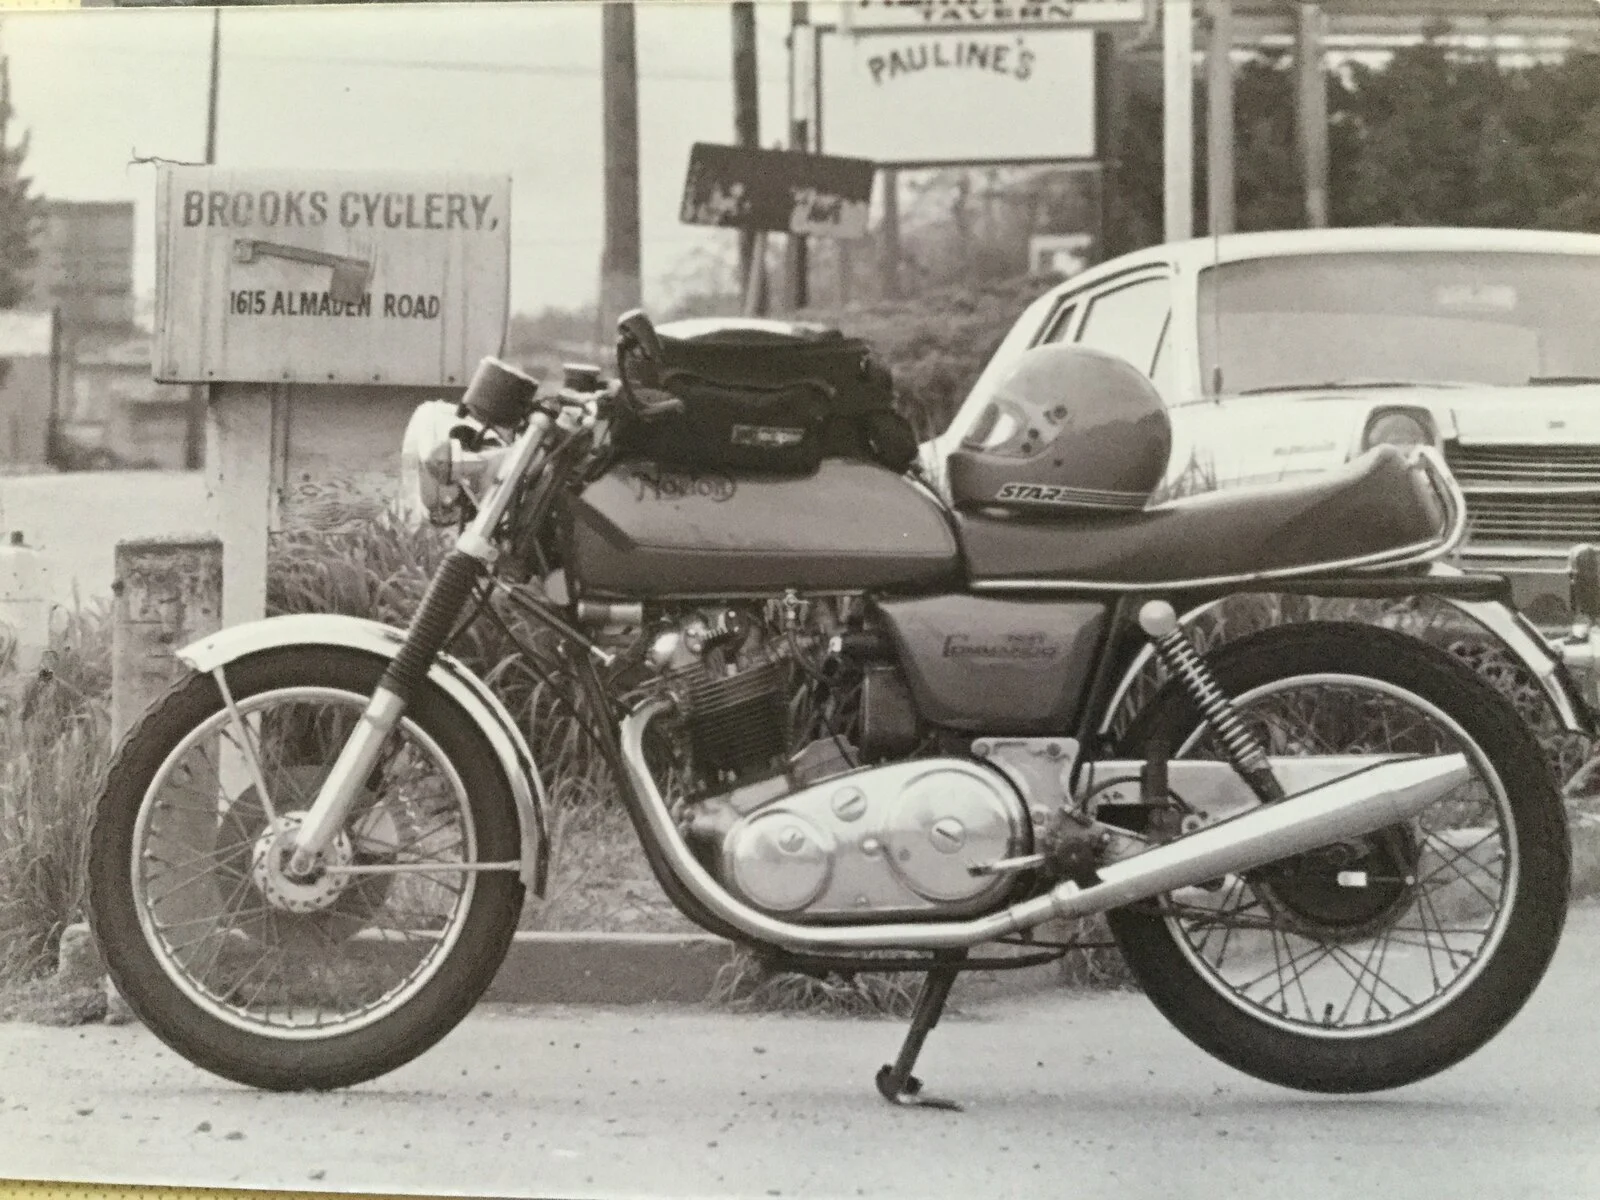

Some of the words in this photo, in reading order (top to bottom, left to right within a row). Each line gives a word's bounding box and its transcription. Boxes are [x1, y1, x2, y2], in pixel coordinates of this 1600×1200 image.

[921, 5, 1073, 21] TAVERN
[867, 37, 1035, 84] PAULINE'S
[183, 190, 329, 227] BROOKS
[338, 193, 498, 231] CYCLERY,
[229, 290, 266, 316] 1615
[383, 292, 441, 319] ROAD
[999, 484, 1062, 500] STAR
